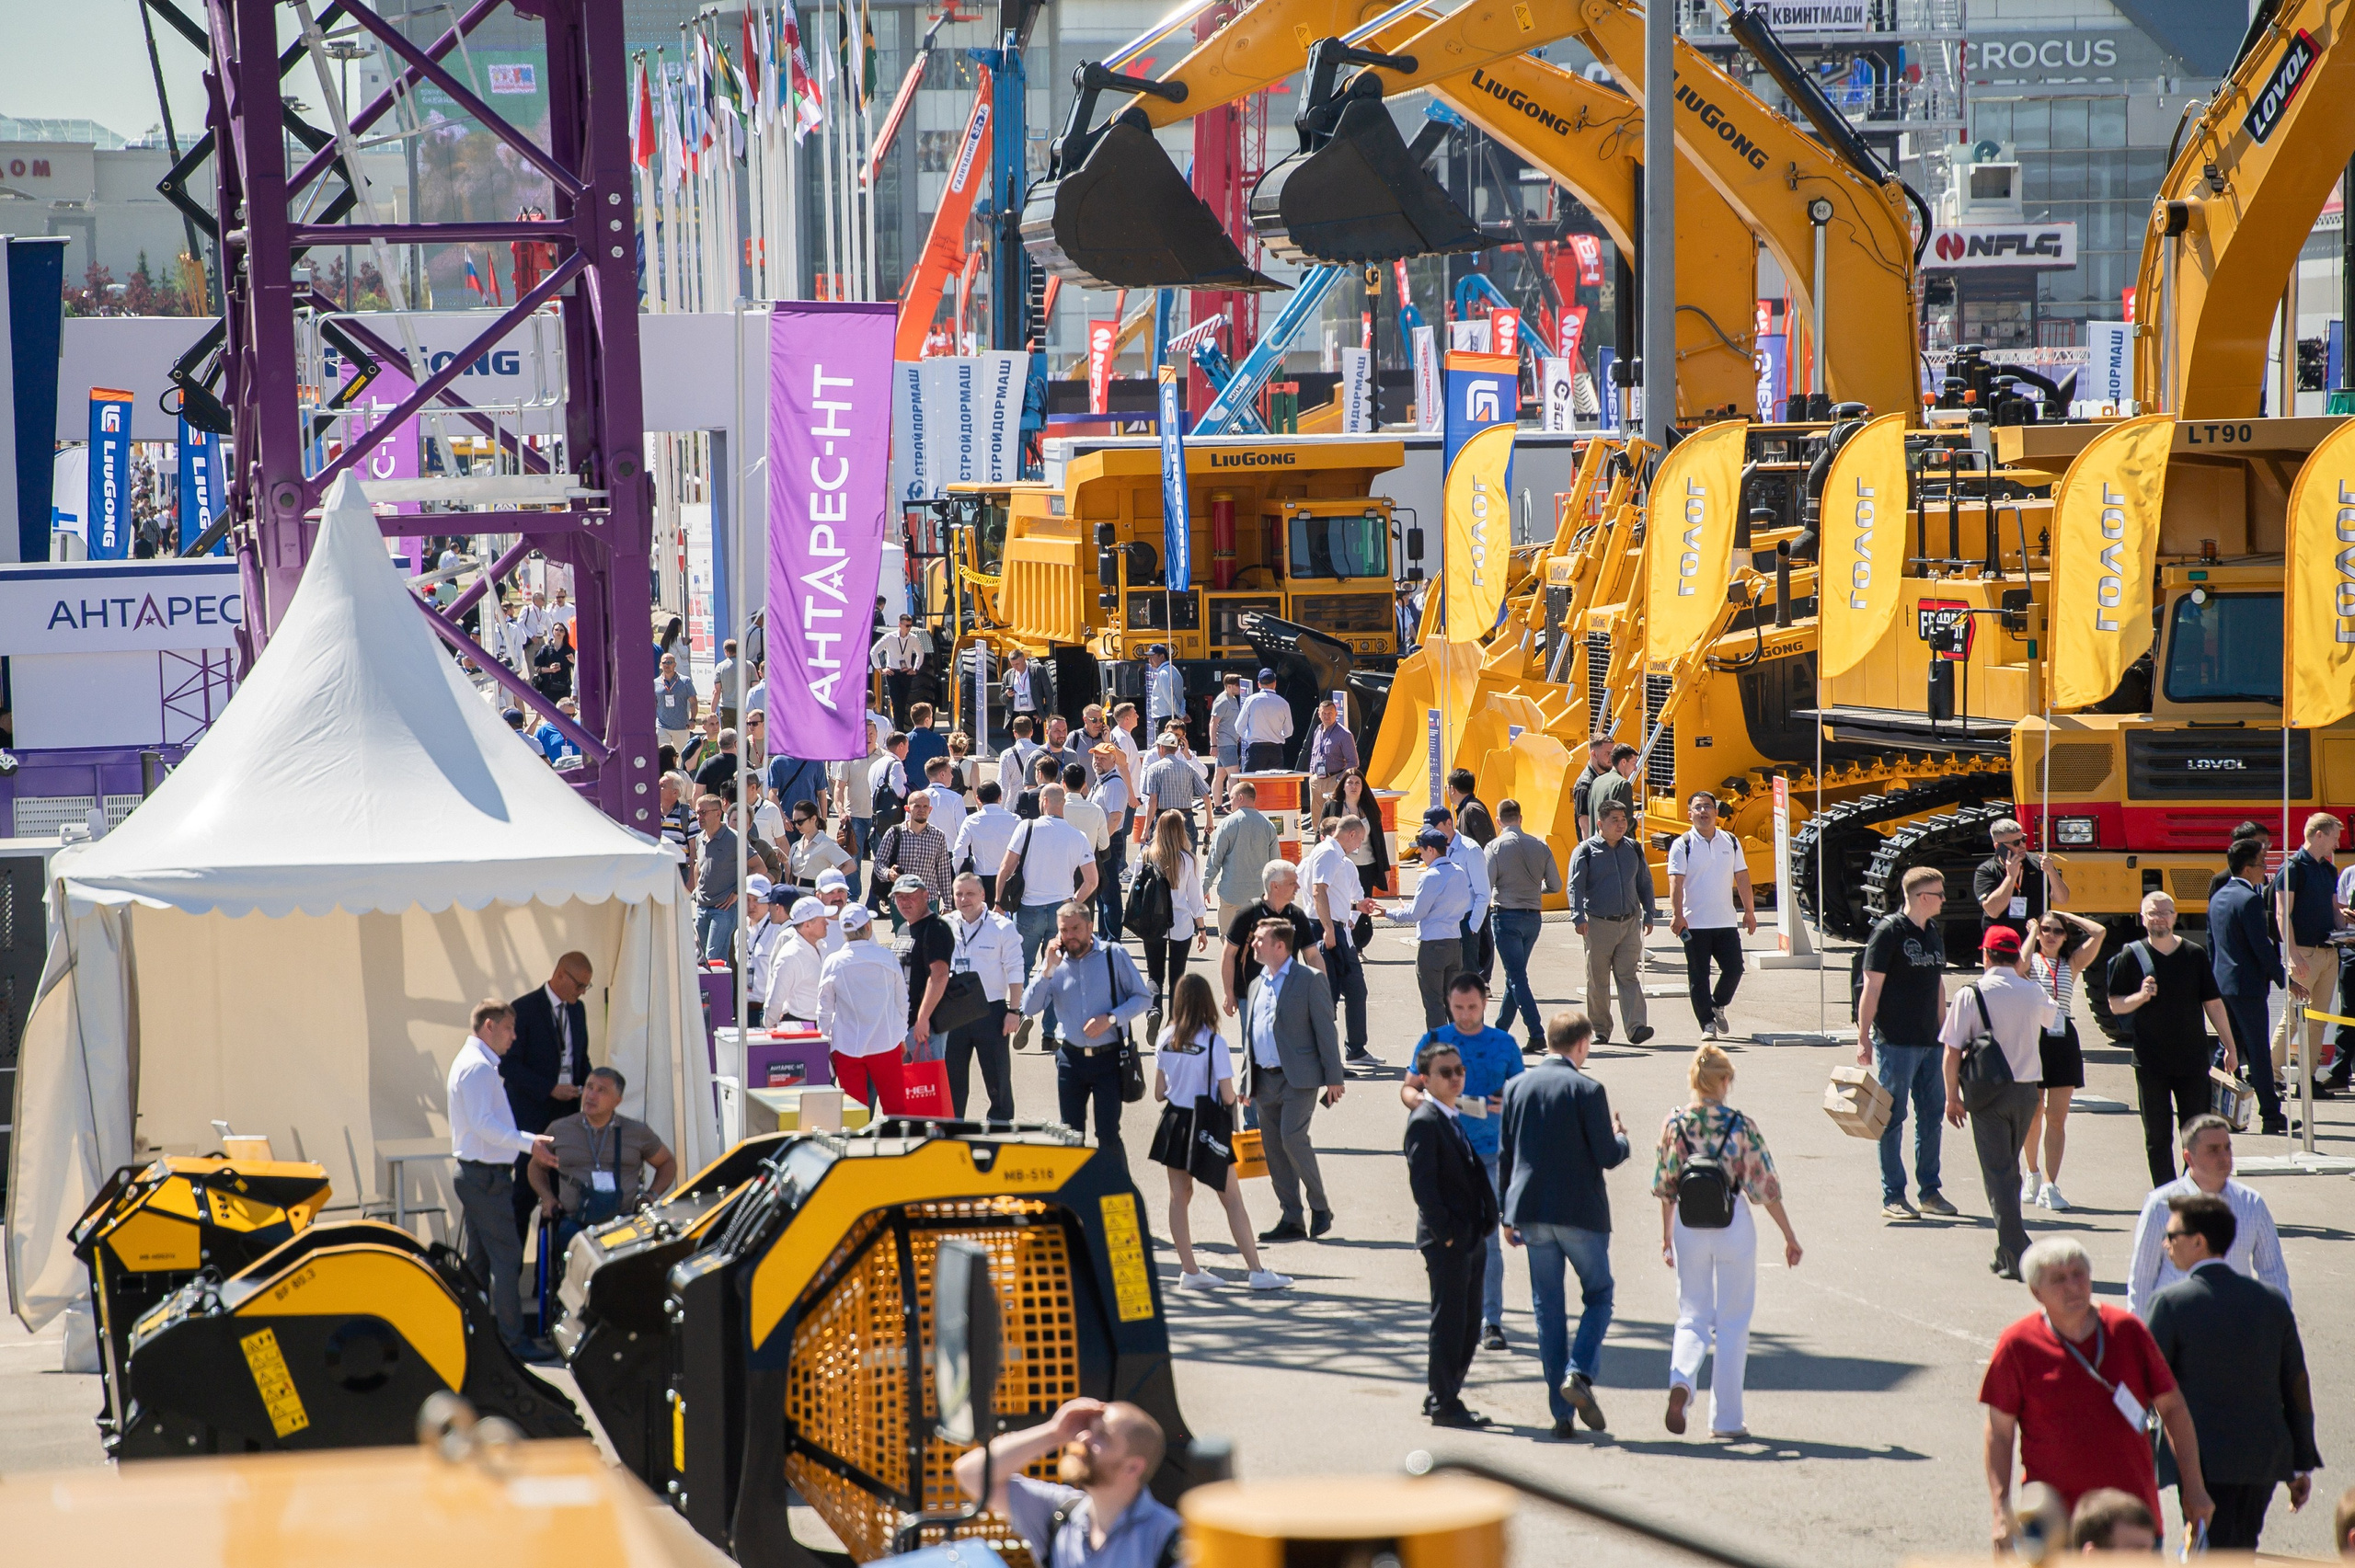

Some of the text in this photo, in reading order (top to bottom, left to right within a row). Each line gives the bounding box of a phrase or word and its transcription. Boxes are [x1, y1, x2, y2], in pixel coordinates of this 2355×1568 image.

[1773, 6, 1863, 25] КВИНТМАДИ
[1957, 39, 2117, 71] CROCUS
[2253, 44, 2309, 137] LOVOL
[1673, 70, 1770, 171] IUGONG
[0, 158, 52, 178] ОМ
[1967, 233, 2062, 258] NFLG
[2108, 329, 2124, 400] ДОРМАШ
[959, 365, 972, 481] СТРОЙДОРМАШ
[991, 360, 1012, 483] СТРОЙДОРМАШ
[2187, 424, 2253, 445] LT90
[102, 441, 117, 548] LIUGONG
[800, 363, 854, 710] АНТАРЕС-НТ
[2187, 759, 2247, 771] LOVOL
